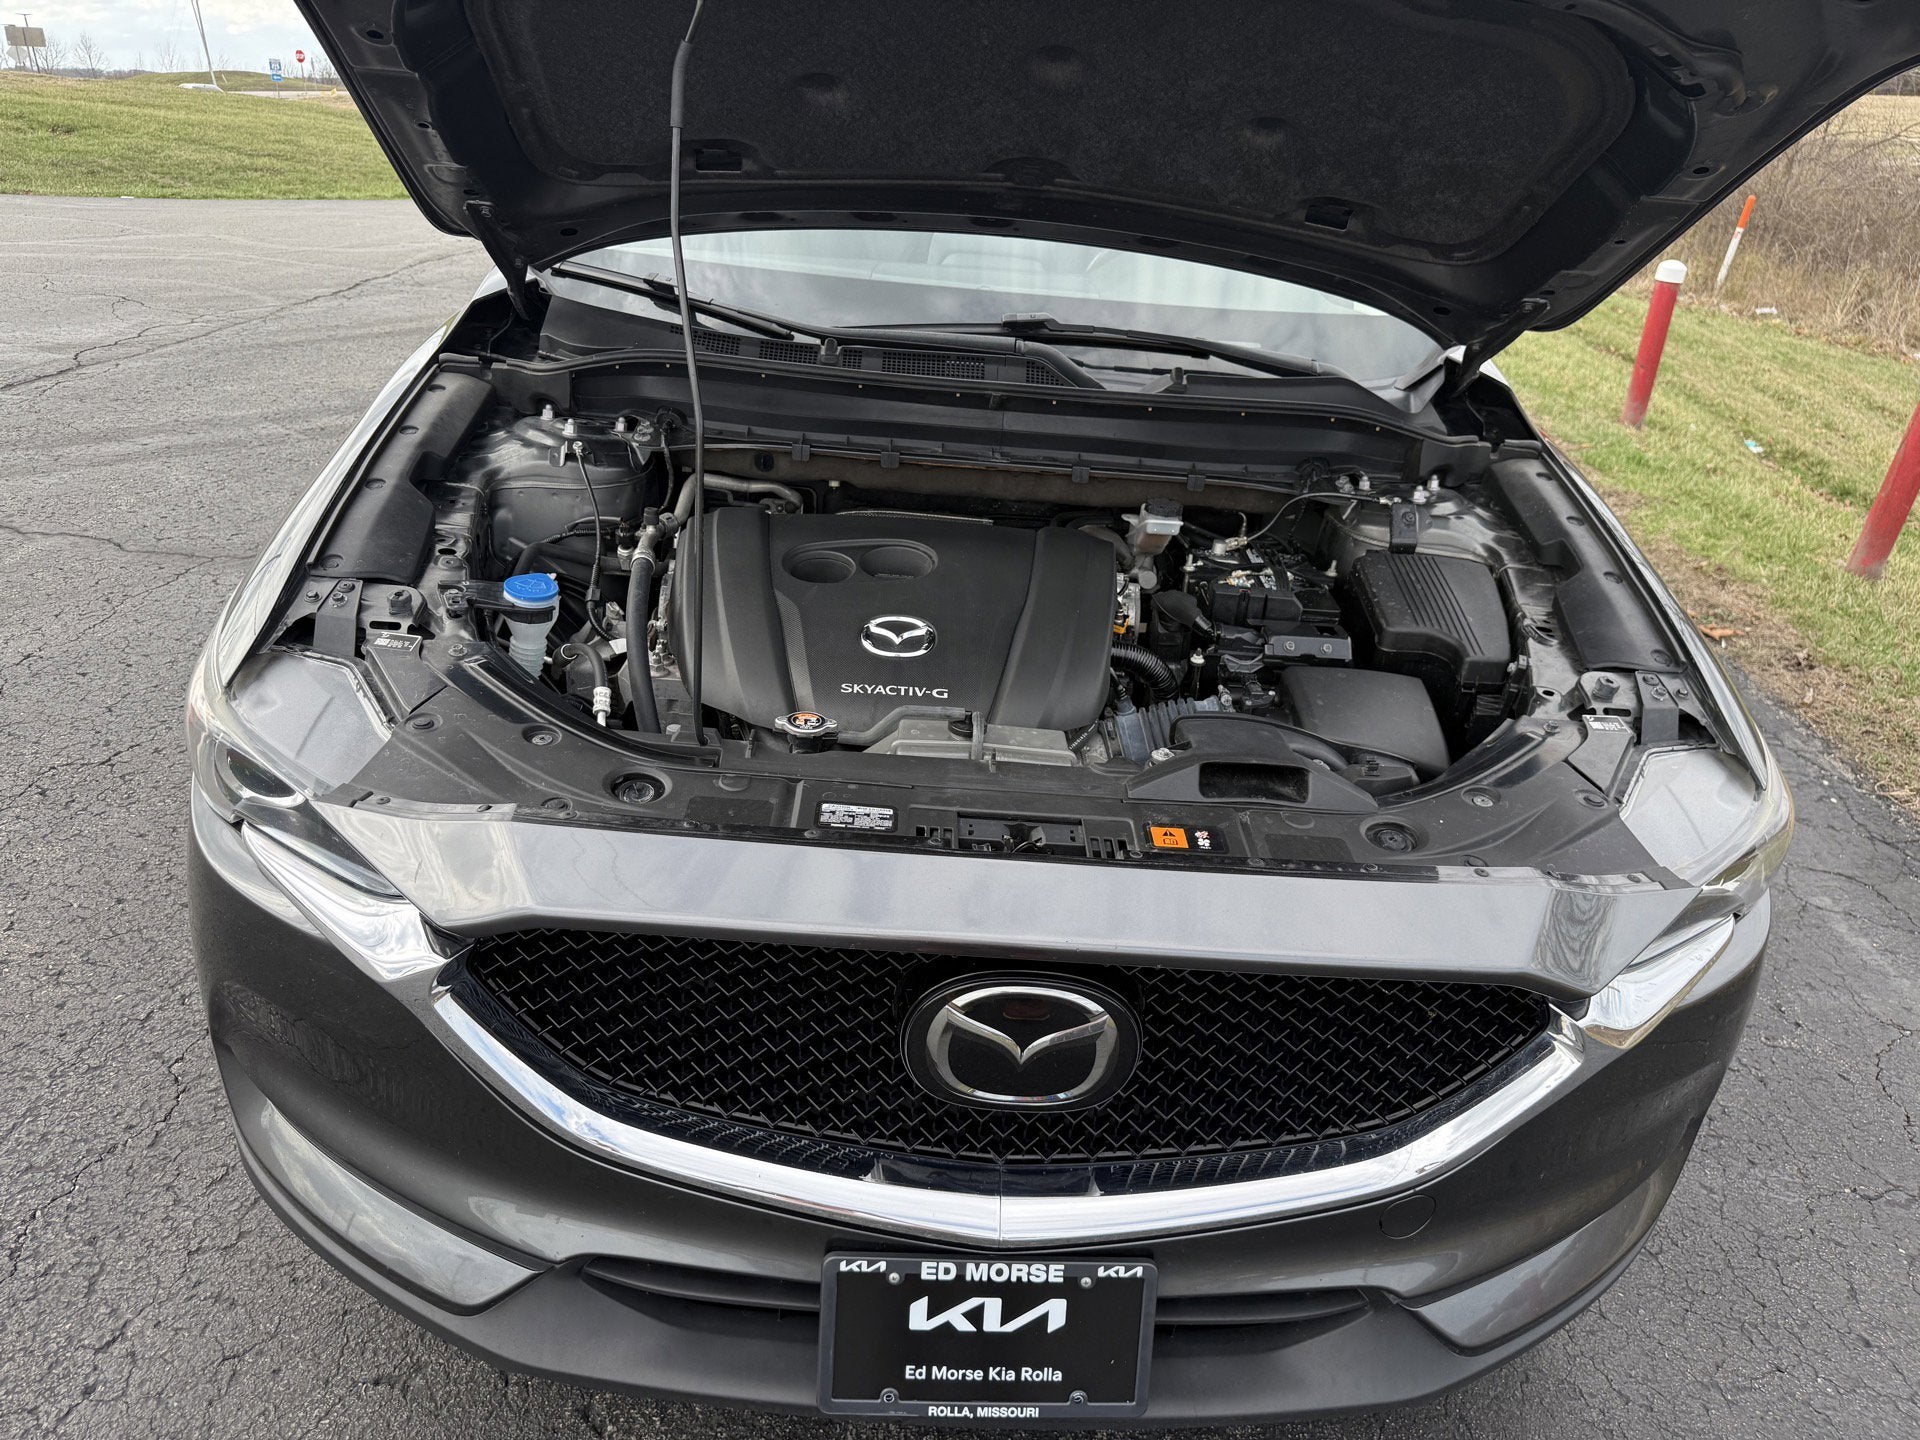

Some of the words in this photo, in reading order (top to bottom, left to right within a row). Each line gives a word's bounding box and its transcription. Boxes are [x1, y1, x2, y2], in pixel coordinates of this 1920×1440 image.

[840, 683, 949, 699] SKYACTIV-G
[839, 1259, 887, 1273] KIA
[920, 1261, 957, 1281] ED
[965, 1262, 1065, 1283] MORSE
[1097, 1265, 1144, 1278] KIA
[908, 1295, 1067, 1334] KIA
[904, 1364, 926, 1380] Ed
[931, 1365, 984, 1381] Morse
[988, 1366, 1016, 1382] Kia
[1020, 1366, 1063, 1382] Rolla
[928, 1405, 974, 1419] ROLLA,
[976, 1406, 1039, 1418] MISSOURI
